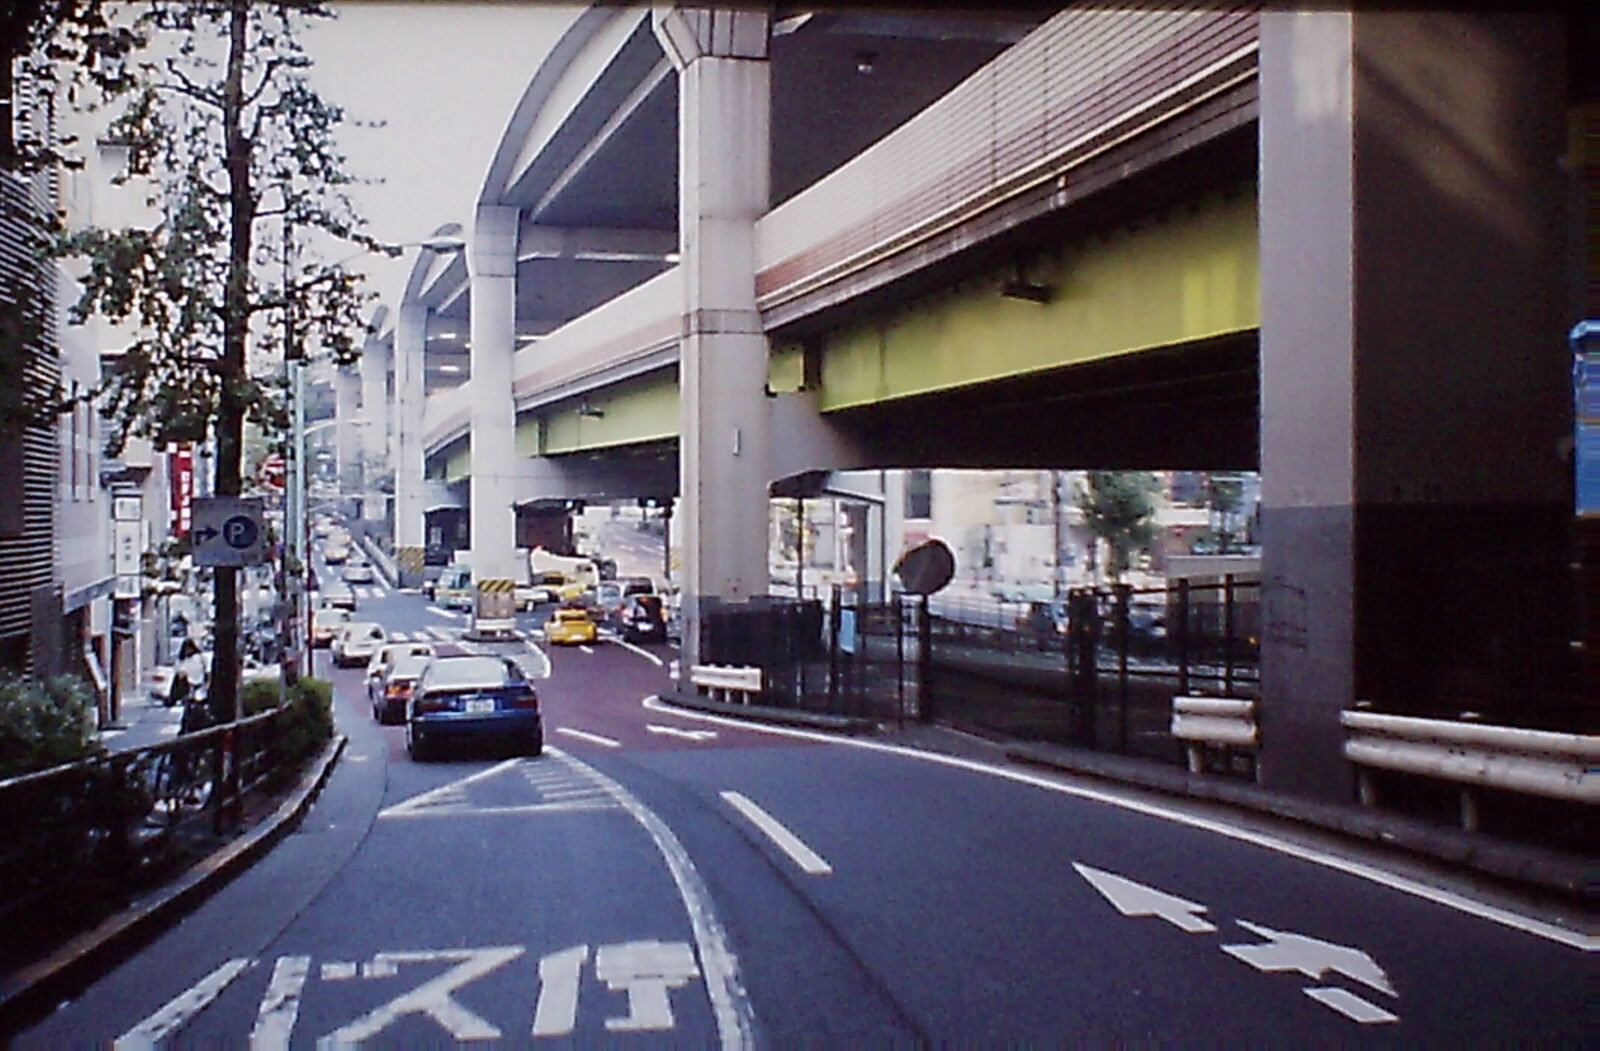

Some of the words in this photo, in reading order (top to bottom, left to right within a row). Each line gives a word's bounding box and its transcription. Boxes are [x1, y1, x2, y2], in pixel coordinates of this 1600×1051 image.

[231, 523, 245, 543] P
[114, 940, 701, 1051] バス停
